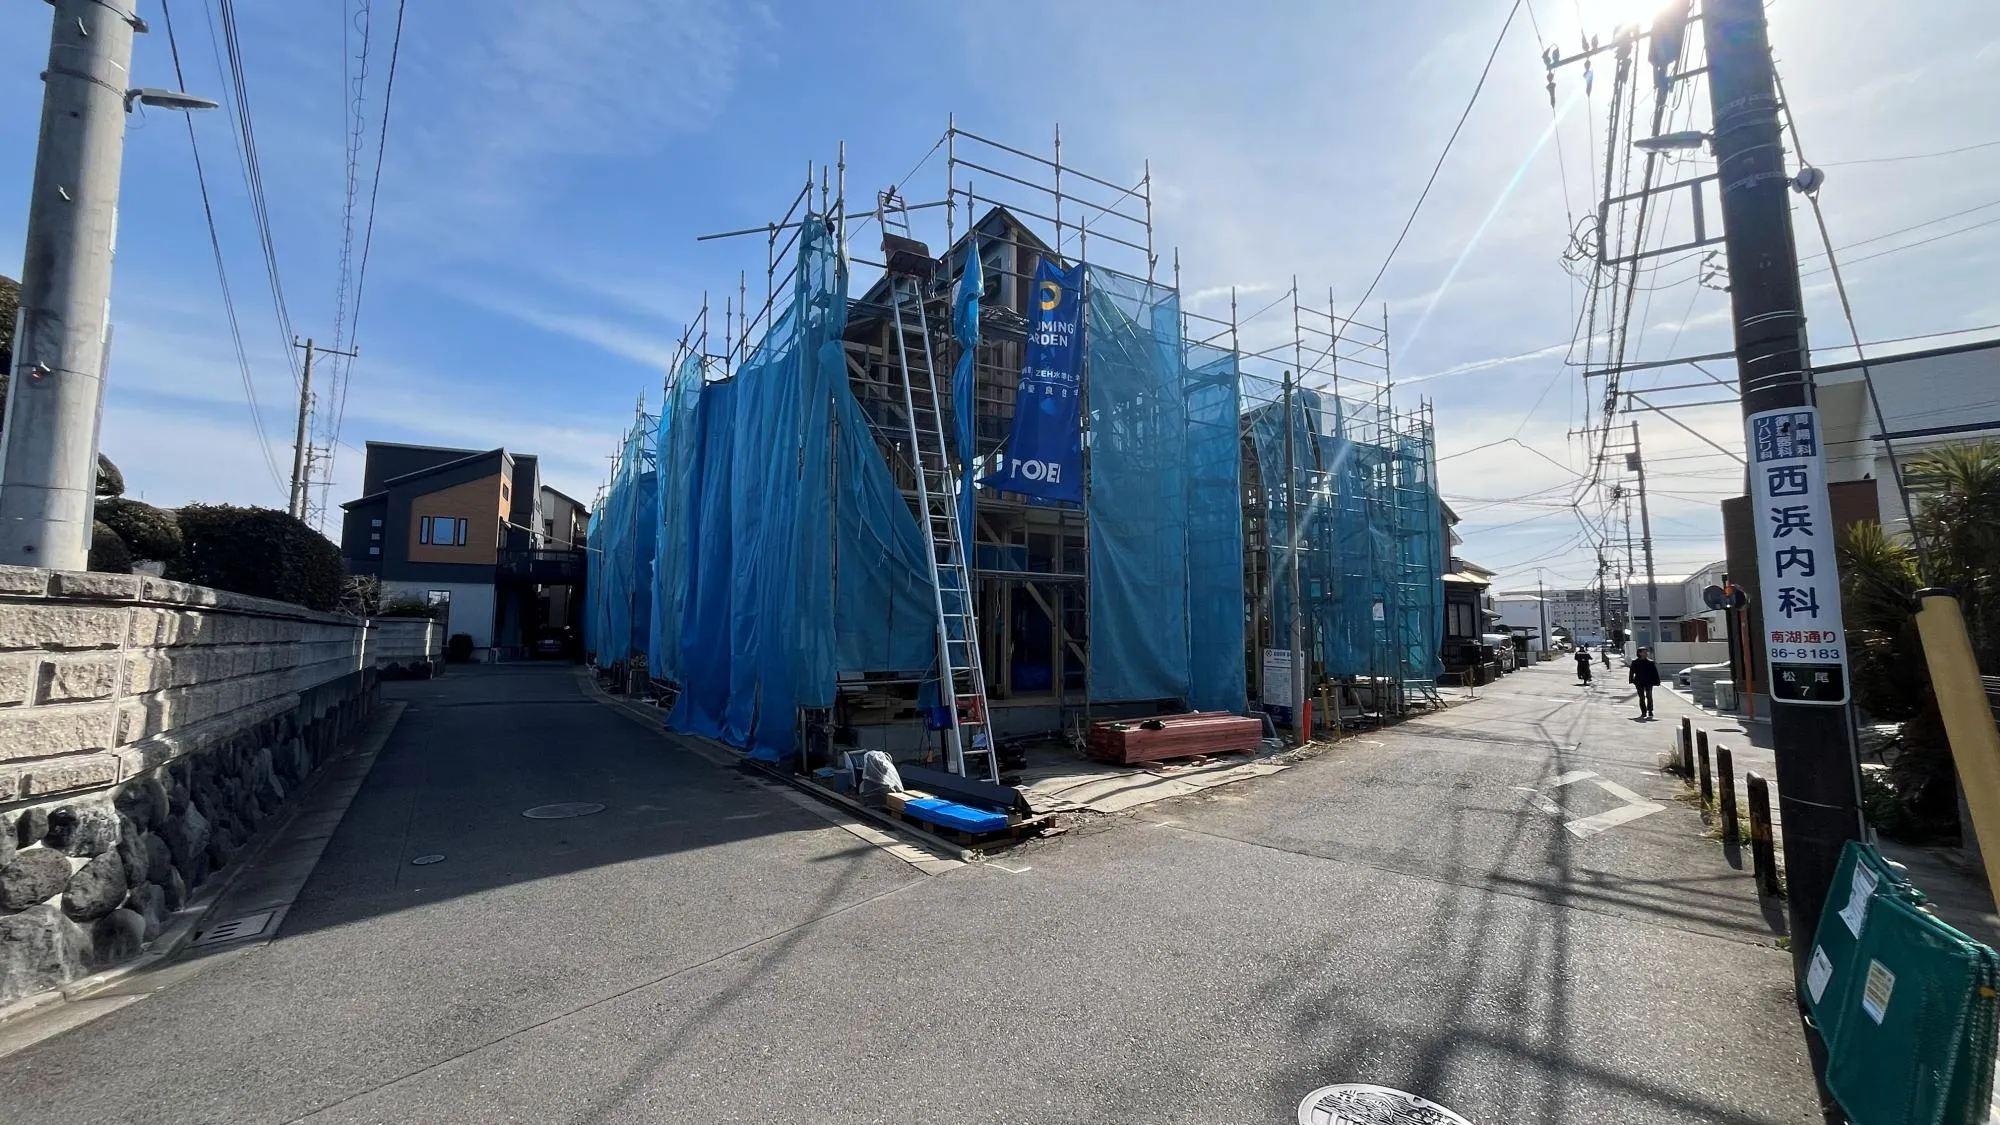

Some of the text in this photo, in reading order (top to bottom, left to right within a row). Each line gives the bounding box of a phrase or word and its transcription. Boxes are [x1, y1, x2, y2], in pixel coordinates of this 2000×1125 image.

[1767, 464, 1820, 619] 西浜内科
[1770, 630, 1837, 644] 南湖通り
[1771, 648, 1841, 659] 86-8183
[1800, 685, 1810, 697] 7
